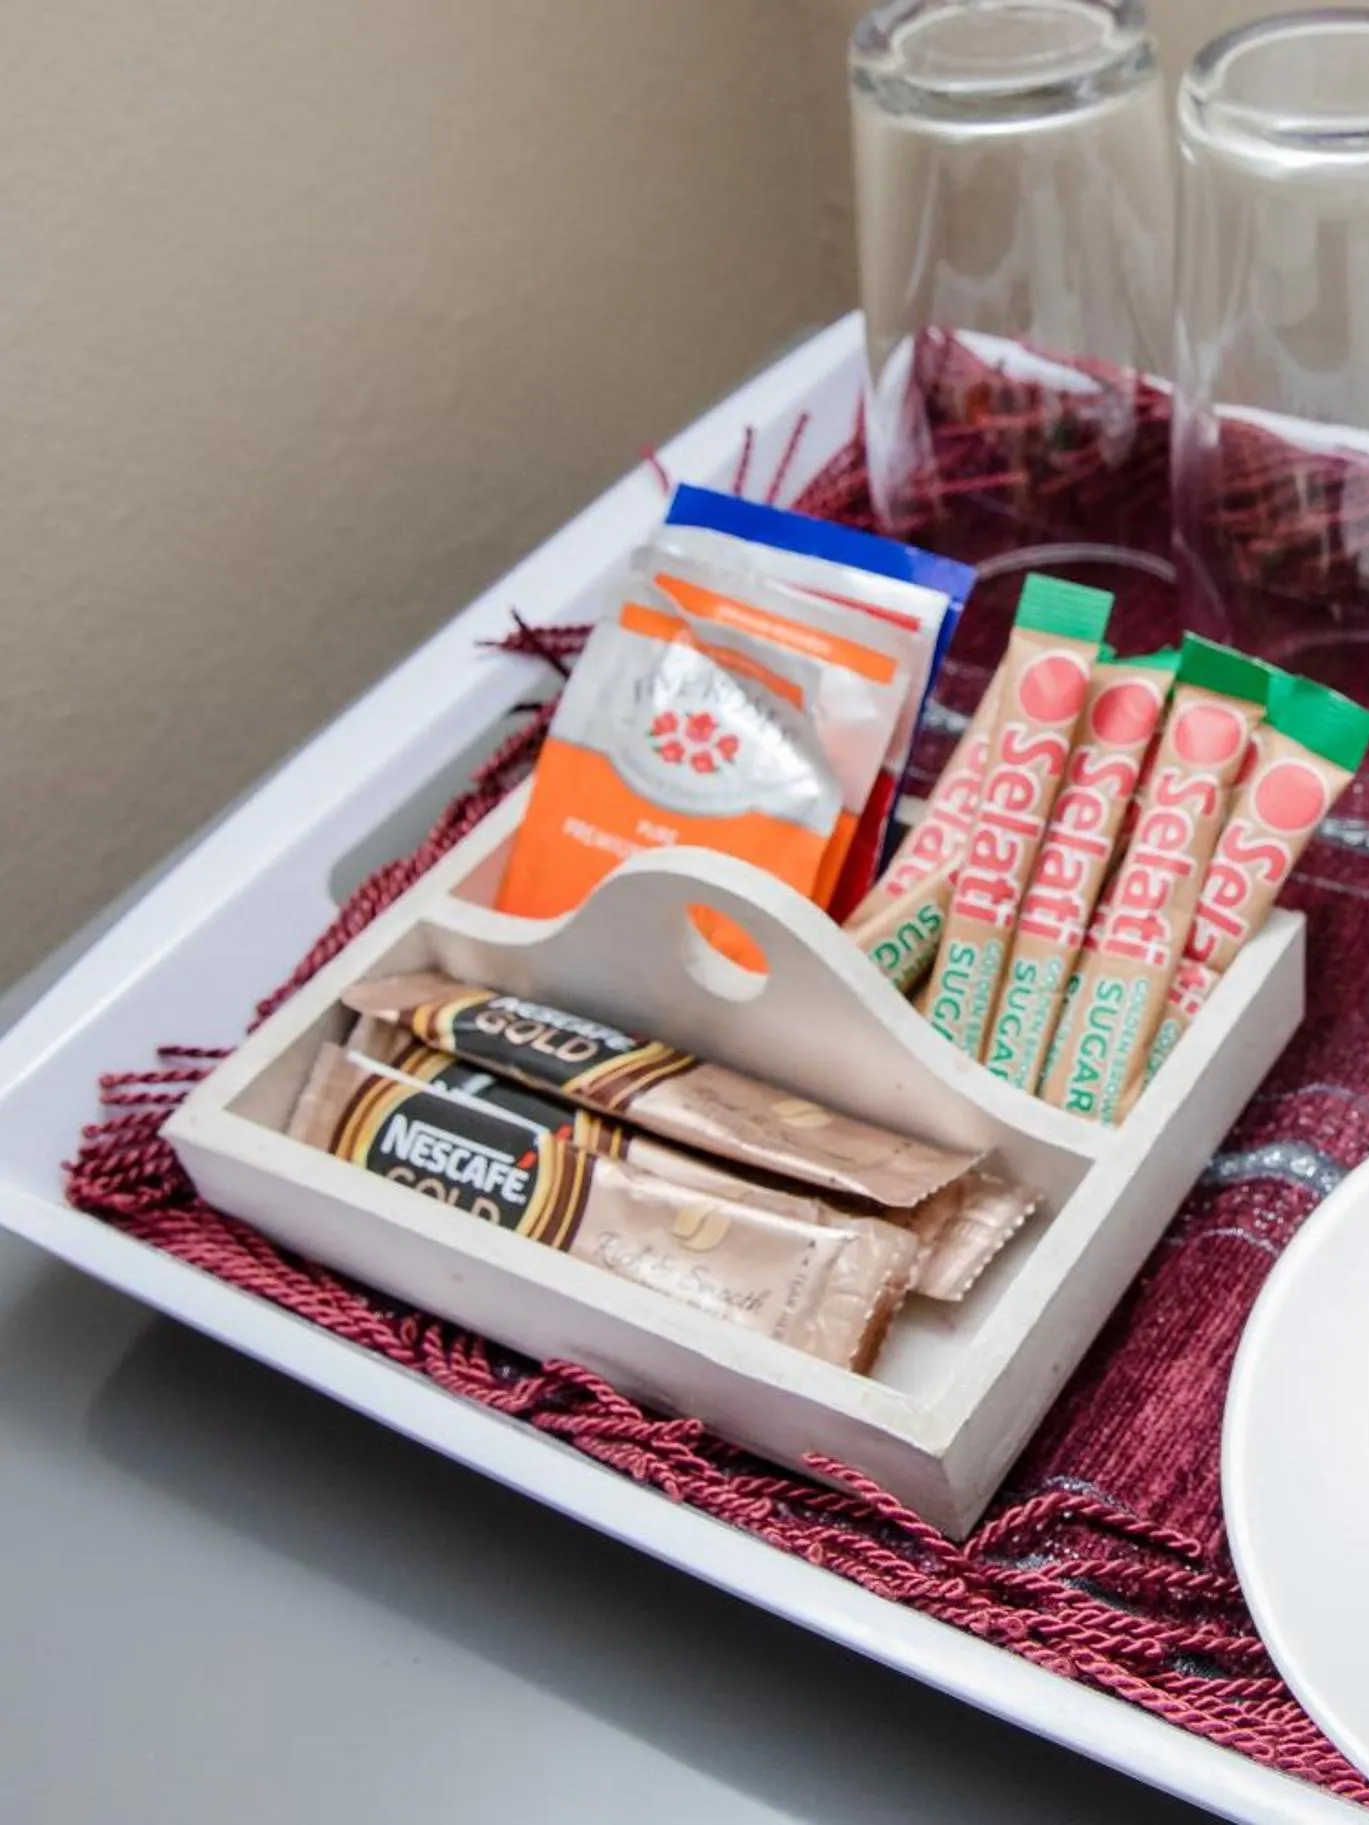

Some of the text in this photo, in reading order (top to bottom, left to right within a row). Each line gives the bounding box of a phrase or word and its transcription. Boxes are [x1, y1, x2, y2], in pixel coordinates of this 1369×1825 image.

[951, 727, 1068, 927] Selati
[1017, 749, 1140, 948] Selati
[1100, 769, 1217, 967] Selati
[871, 904, 942, 970] SUG
[929, 942, 976, 1043] SUG
[474, 1008, 599, 1063] GOLD
[1065, 979, 1125, 1114] SUGAR
